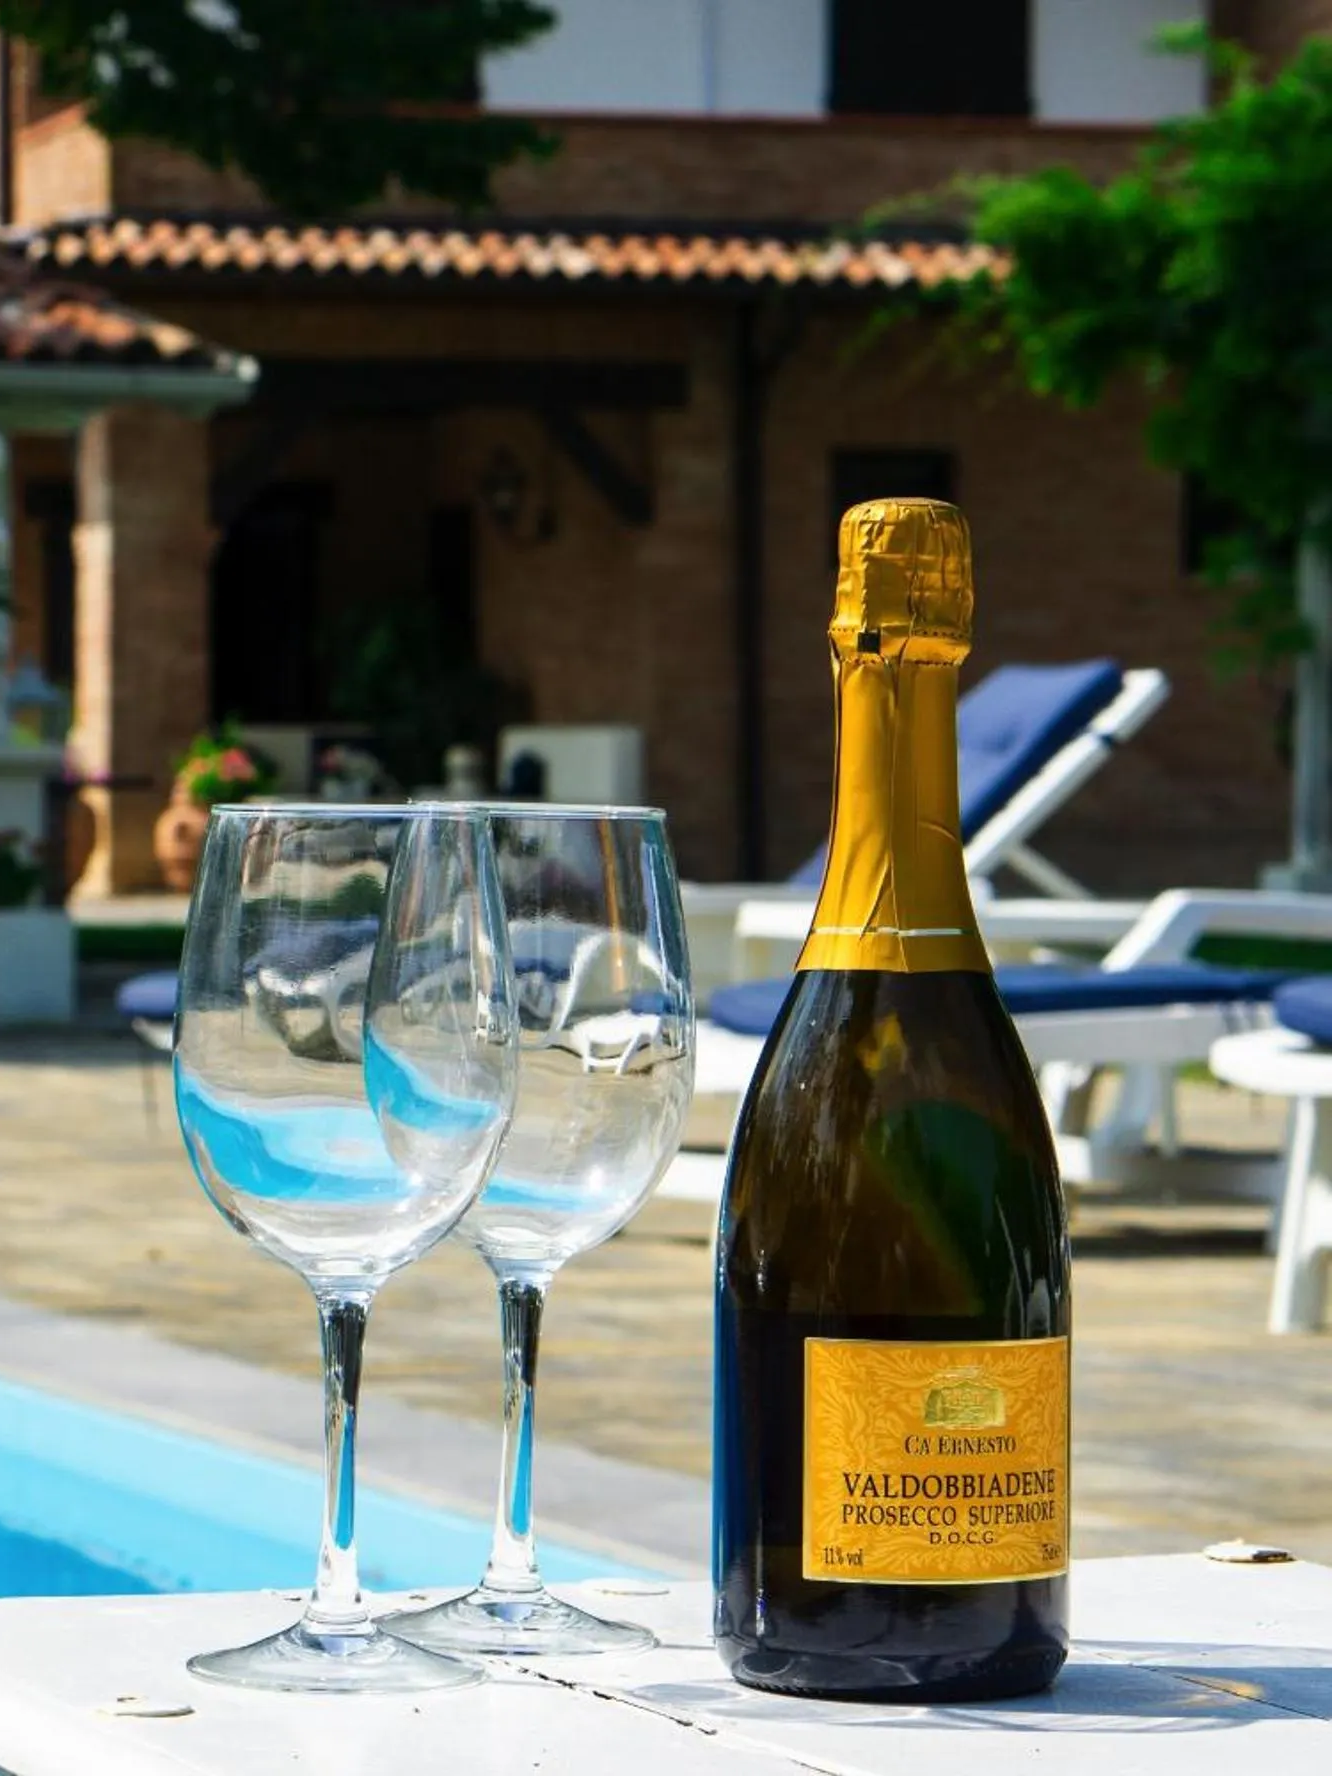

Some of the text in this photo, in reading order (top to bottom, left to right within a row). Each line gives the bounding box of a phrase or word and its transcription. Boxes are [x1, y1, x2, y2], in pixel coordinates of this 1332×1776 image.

[937, 1435, 1016, 1455] ERNESTO
[842, 1469, 1056, 1499] VALDOBBIADENE
[842, 1500, 1055, 1527] PROSECCO SUPERIORE
